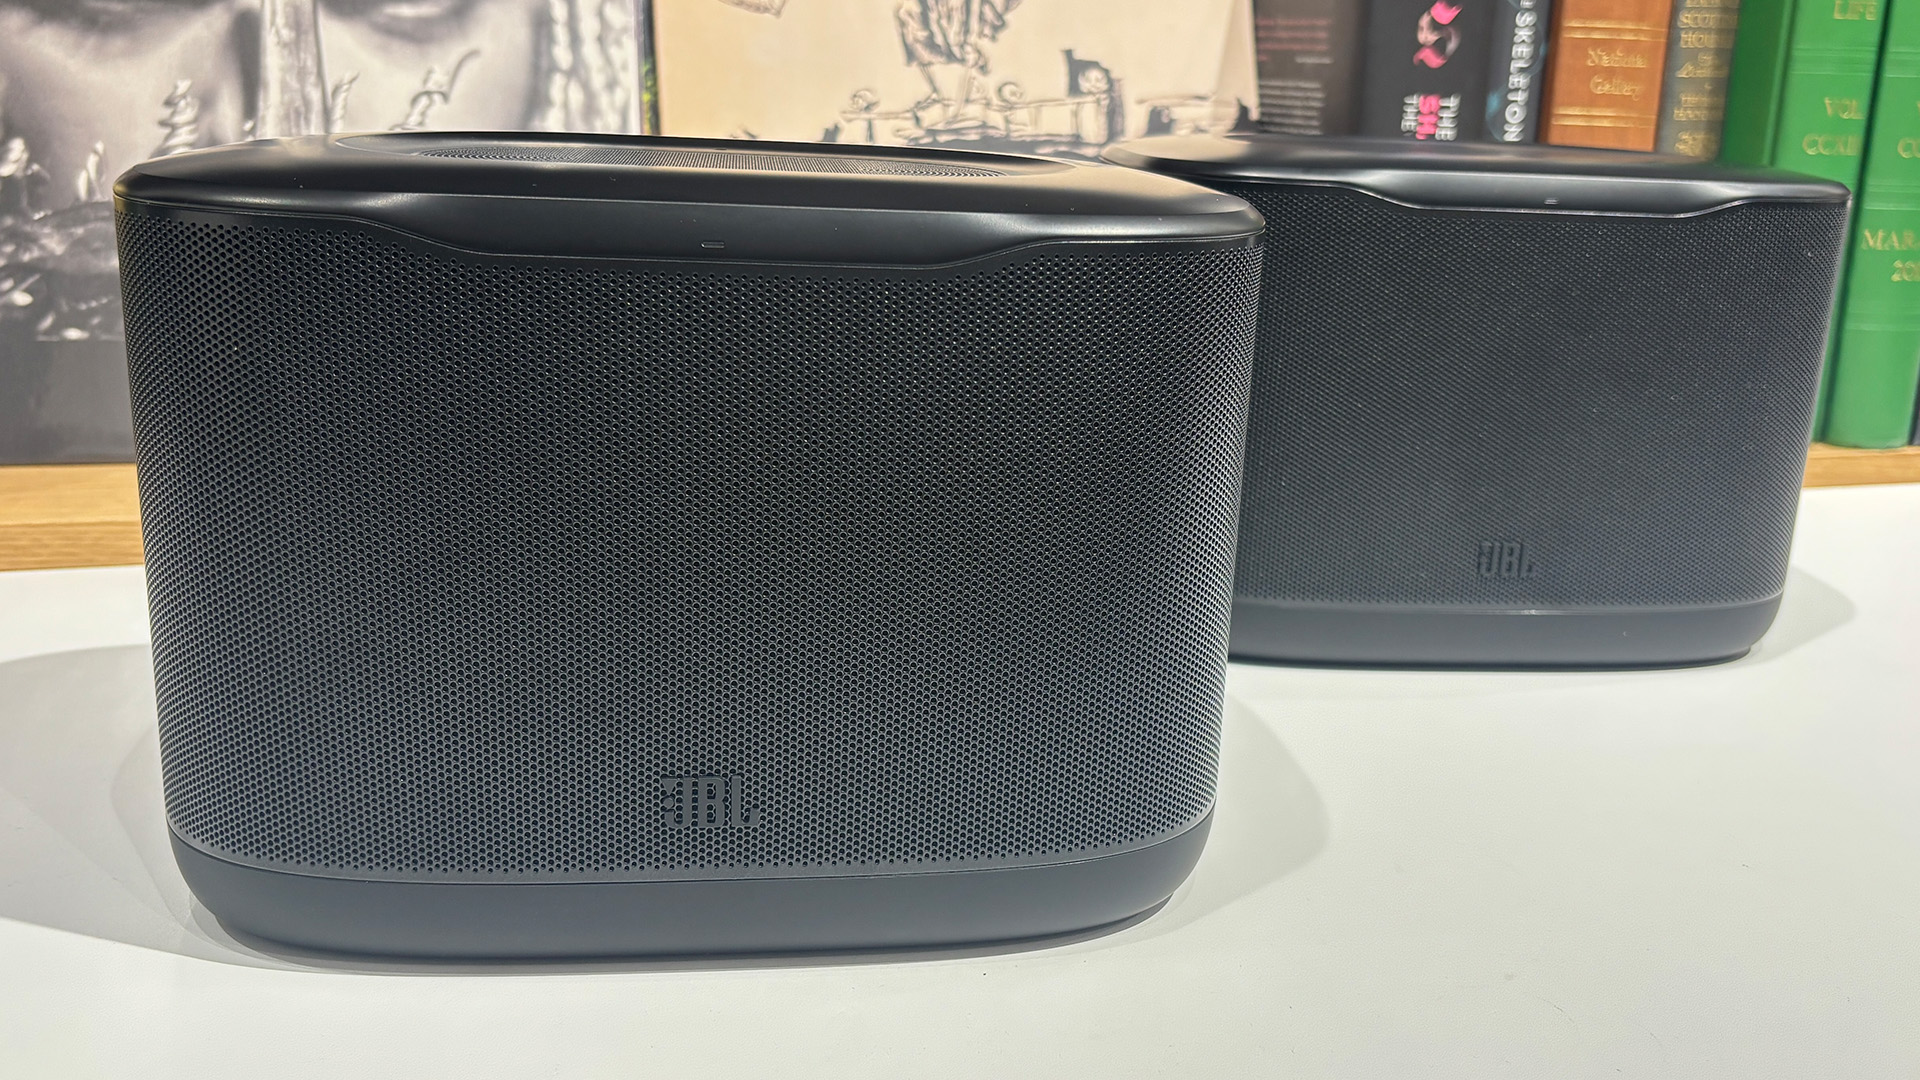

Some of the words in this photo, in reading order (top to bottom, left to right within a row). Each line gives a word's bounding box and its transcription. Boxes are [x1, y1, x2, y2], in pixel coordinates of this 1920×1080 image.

[1503, 9, 1538, 142] SKELETON
[1401, 94, 1420, 132] THE
[1435, 93, 1461, 141] THE
[1861, 228, 1920, 251] MAR
[1478, 541, 1536, 578] JBL
[661, 776, 760, 829] JBL
